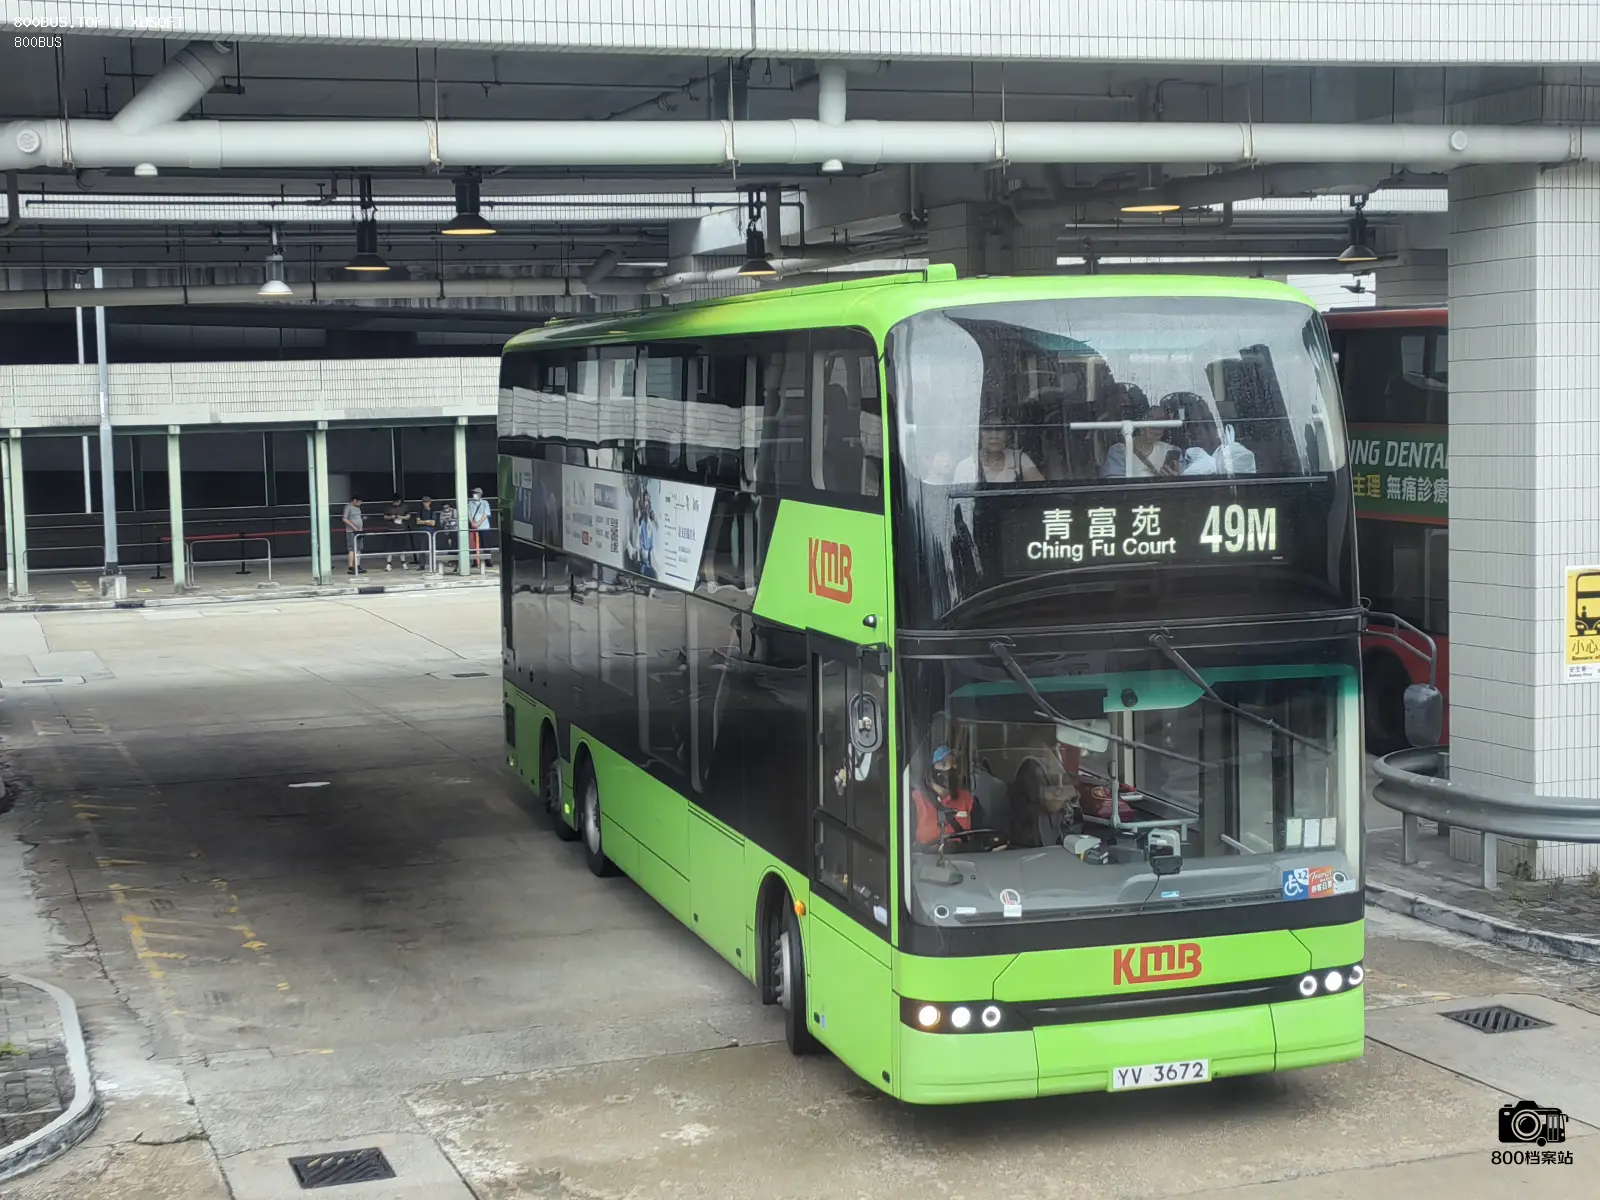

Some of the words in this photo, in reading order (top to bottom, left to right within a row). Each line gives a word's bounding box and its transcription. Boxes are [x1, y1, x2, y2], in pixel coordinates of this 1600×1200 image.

[1348, 439, 1380, 466] ING
[1352, 473, 1381, 498] 主理
[1386, 474, 1449, 504] 無痛診療
[1042, 505, 1161, 540] 青富苑
[1200, 503, 1278, 554] 49M
[1027, 541, 1084, 563] Ching
[1091, 538, 1115, 557] Fu
[1122, 536, 1177, 556] Court
[1572, 640, 1600, 654] 小心
[1118, 1068, 1142, 1085] YV
[1153, 1062, 1204, 1082] 3672
